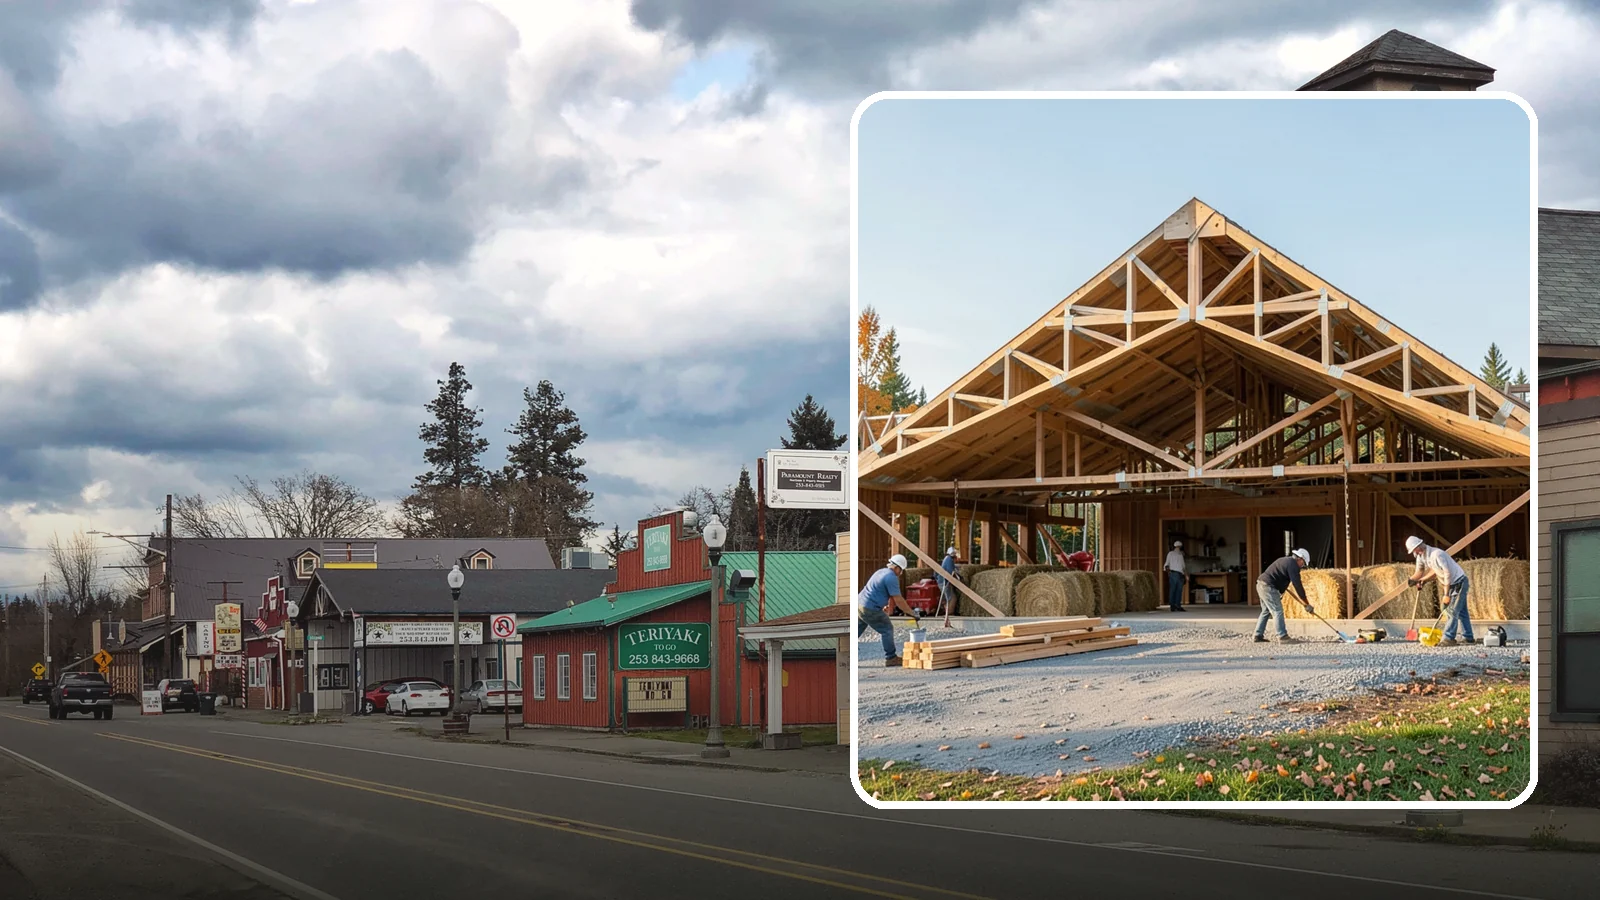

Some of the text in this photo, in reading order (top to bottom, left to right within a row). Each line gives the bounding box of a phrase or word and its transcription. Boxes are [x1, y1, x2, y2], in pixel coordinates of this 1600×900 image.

[624, 627, 702, 646] TERIYAKI
[628, 654, 700, 664] 253 843-9668
